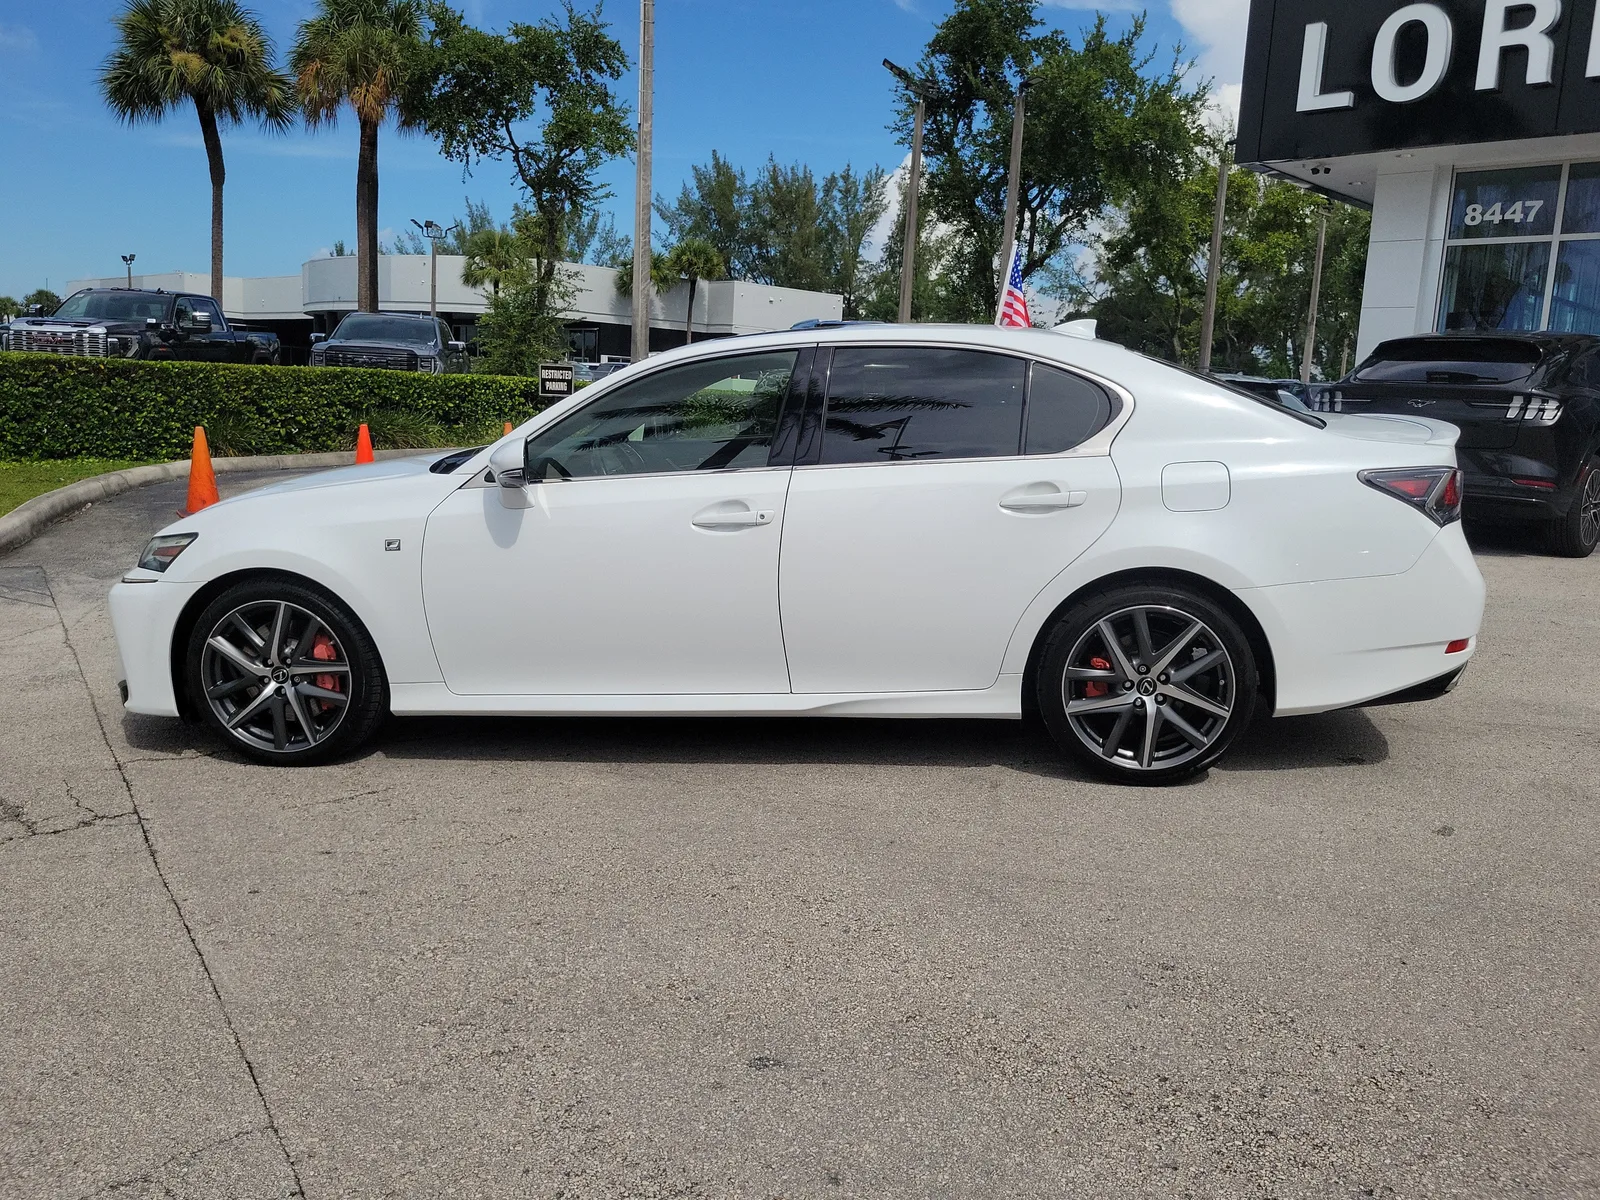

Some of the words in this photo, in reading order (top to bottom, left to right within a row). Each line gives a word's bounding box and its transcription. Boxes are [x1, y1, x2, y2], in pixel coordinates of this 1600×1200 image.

[1464, 200, 1544, 226] 8447
[541, 369, 572, 379] RESTRICTED
[545, 381, 567, 391] PARKING
